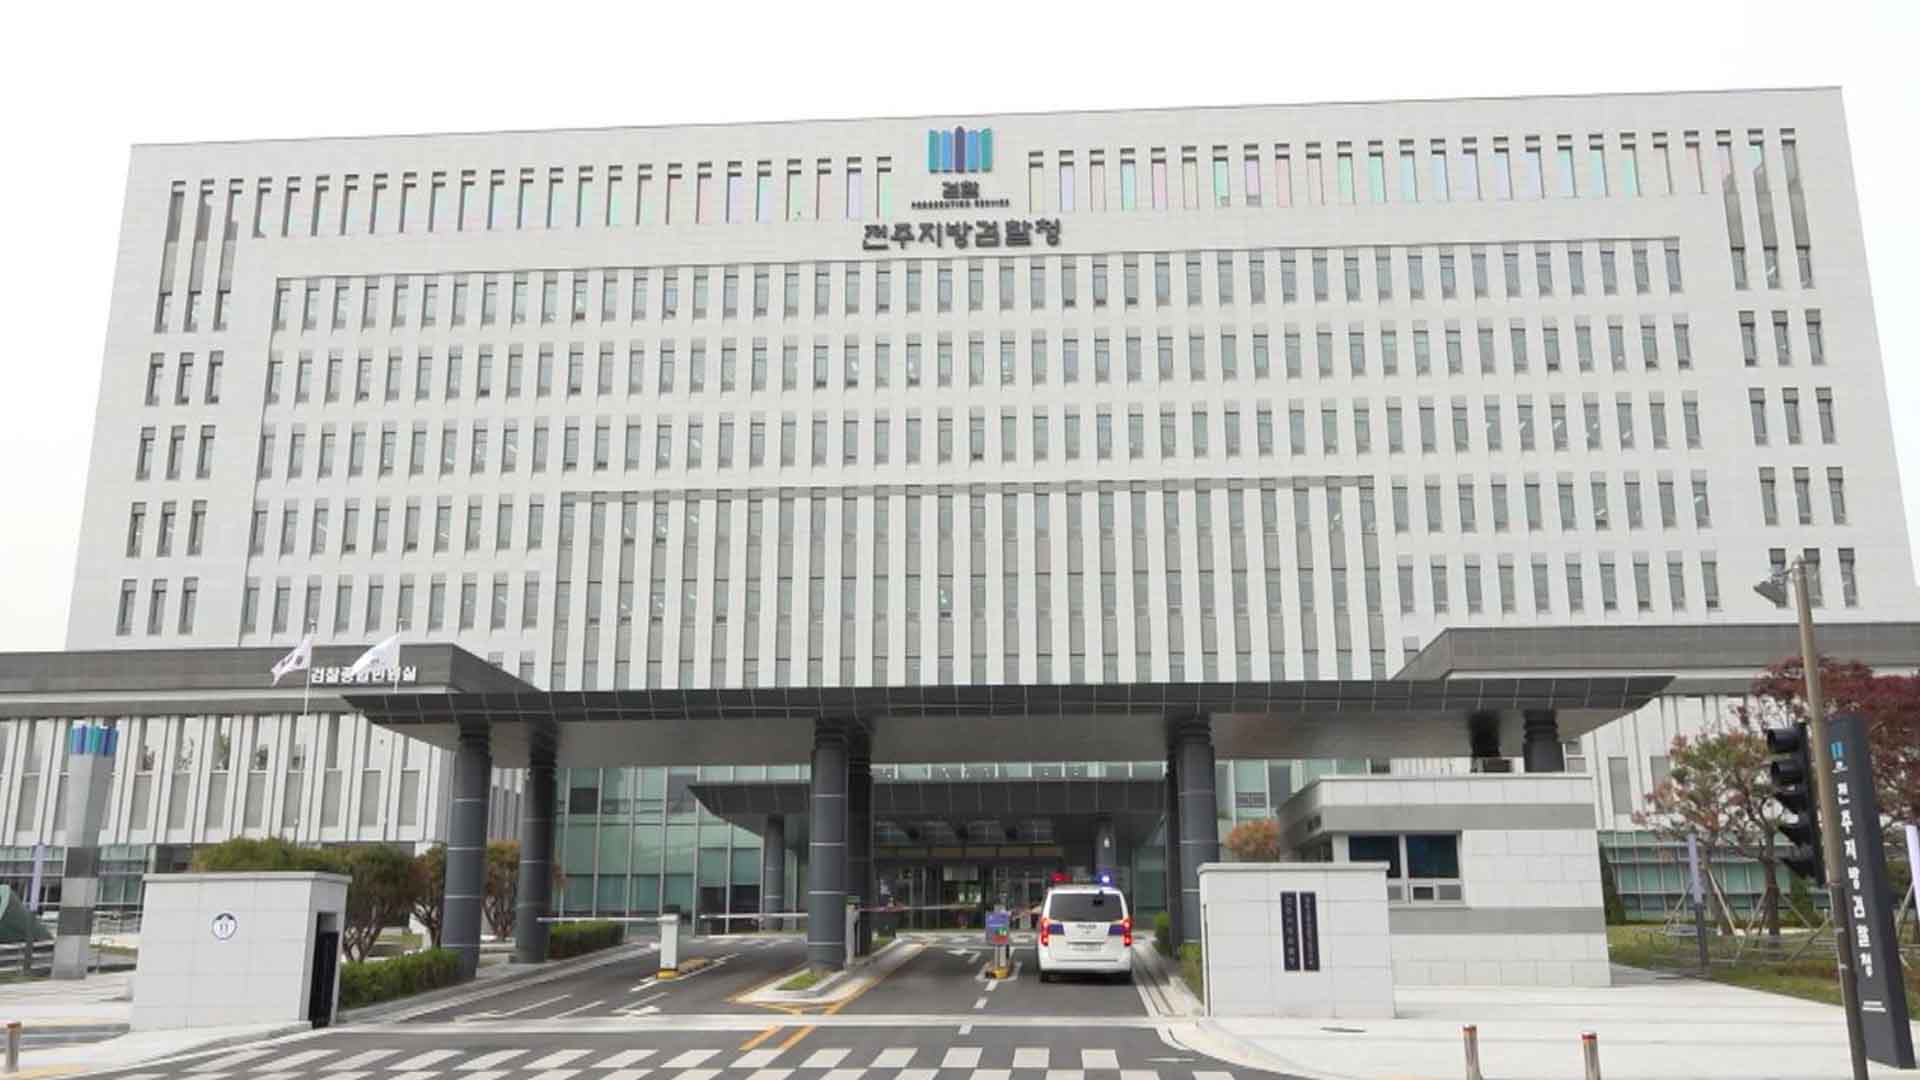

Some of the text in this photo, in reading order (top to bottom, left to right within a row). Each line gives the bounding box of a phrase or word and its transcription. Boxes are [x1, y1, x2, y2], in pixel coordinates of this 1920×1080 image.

[942, 180, 980, 199] 검찰
[863, 218, 1061, 250] 전주지방검찰청
[1836, 782, 1874, 978] 전주지방검찰청
